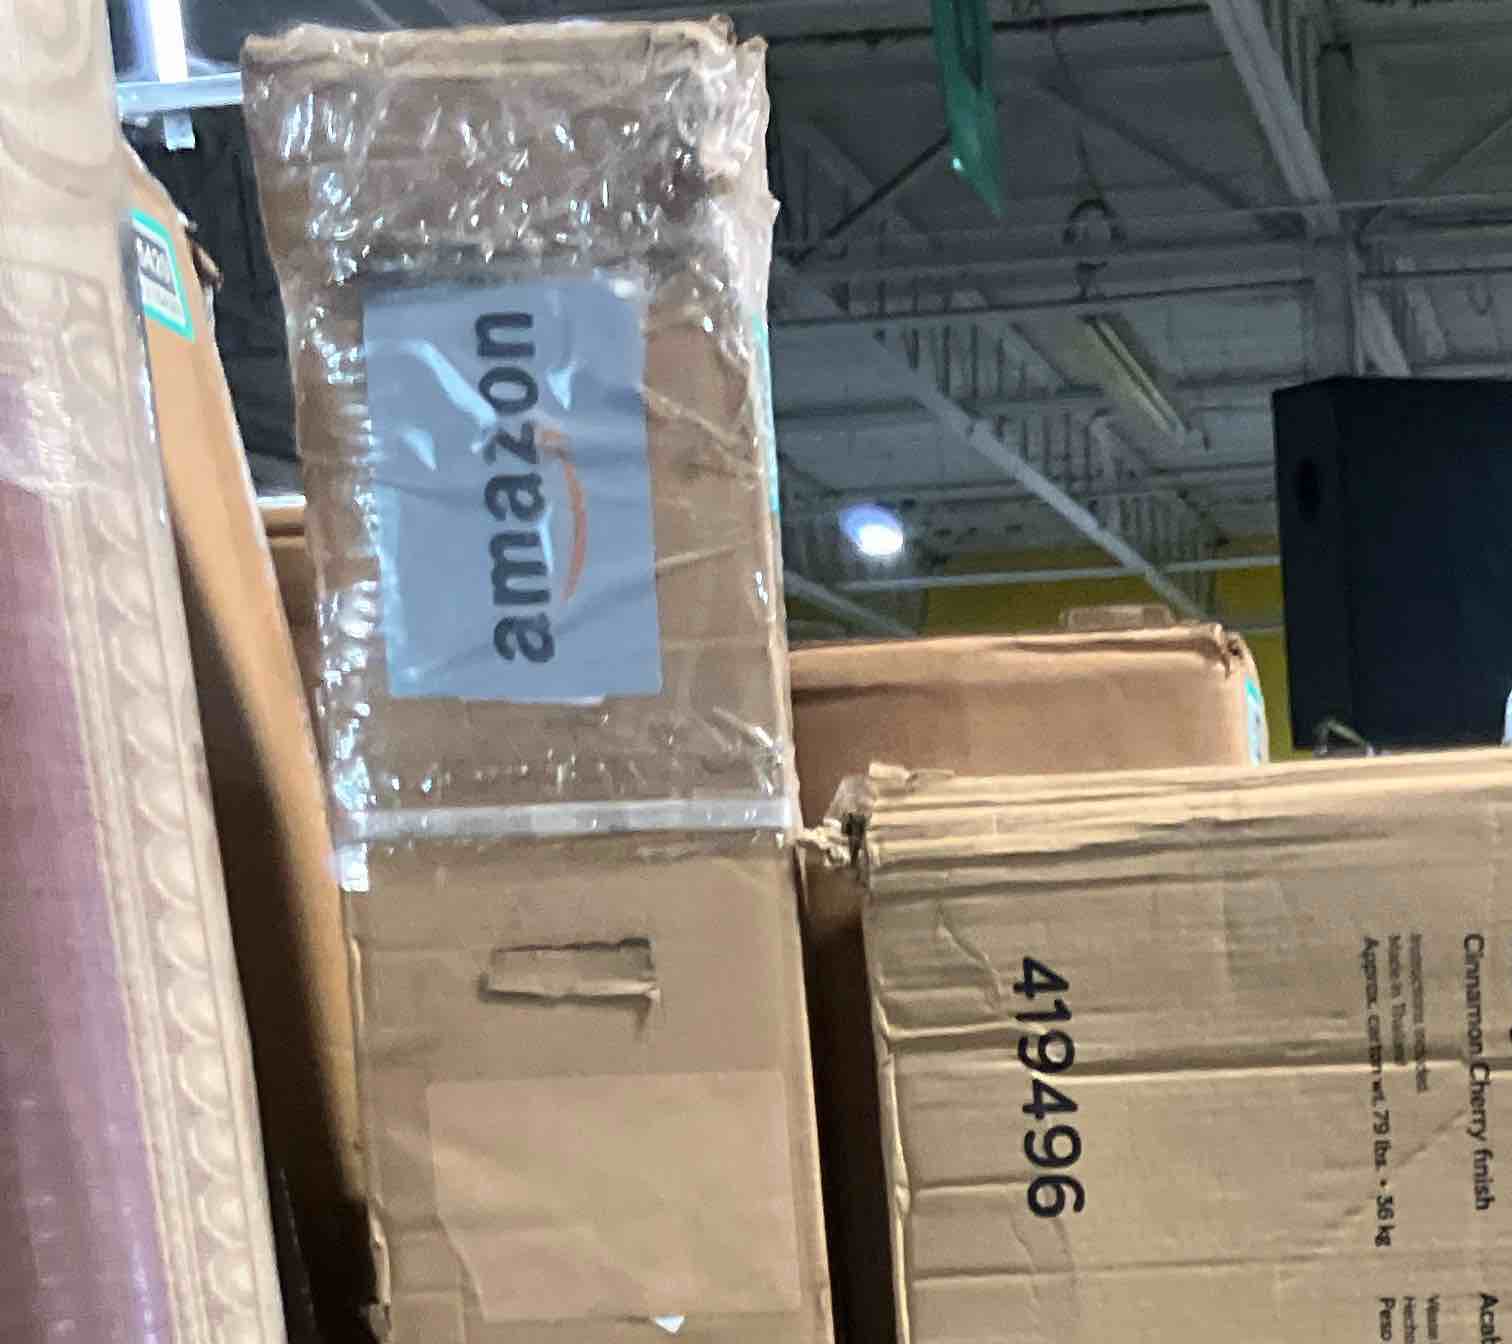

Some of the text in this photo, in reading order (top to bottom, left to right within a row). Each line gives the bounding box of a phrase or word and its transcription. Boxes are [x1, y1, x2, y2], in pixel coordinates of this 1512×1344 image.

[473, 311, 555, 664] amazon
[1362, 937, 1380, 1009] Approx.
[1012, 956, 1086, 1218] 419496
[1463, 933, 1495, 1211] Cinnamon Cherry finish
[1372, 1109, 1391, 1135] 79
[1374, 1225, 1397, 1248] kg
[1379, 1297, 1396, 1341] Peso
